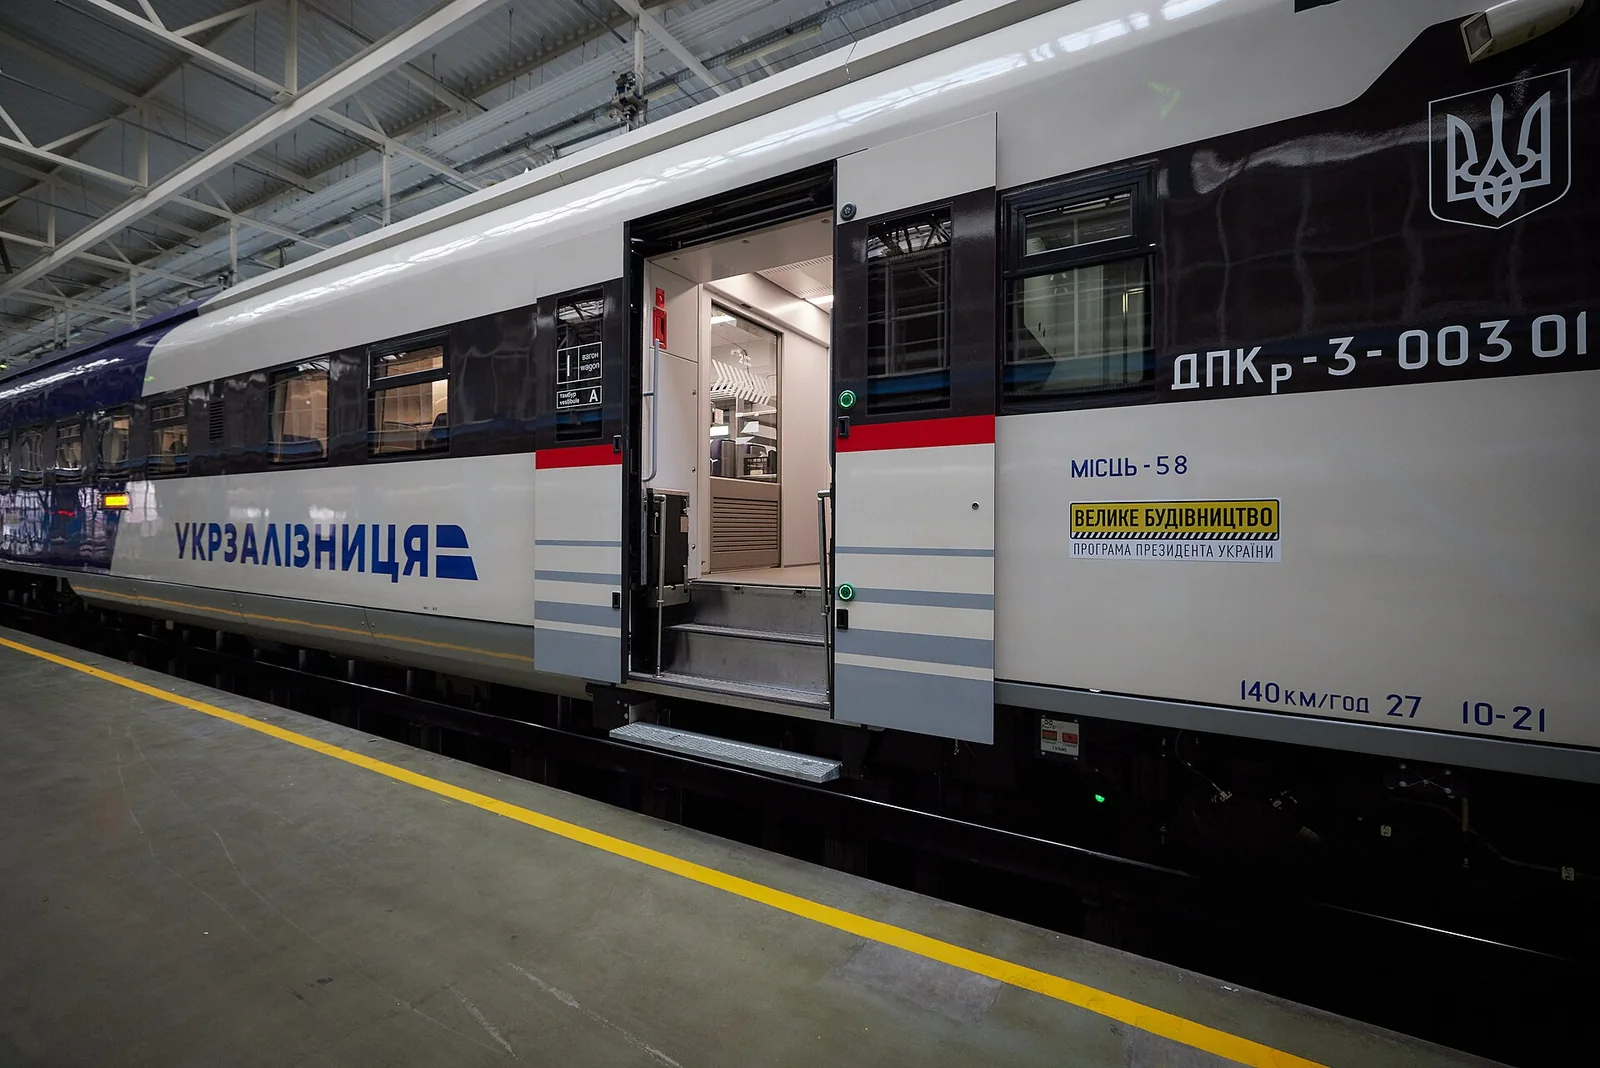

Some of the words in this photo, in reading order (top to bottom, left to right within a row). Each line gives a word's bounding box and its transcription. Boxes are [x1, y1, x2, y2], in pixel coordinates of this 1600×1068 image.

[582, 352, 599, 361] вагон
[580, 362, 600, 372] wagon
[1074, 508, 1139, 527] ВЕЛИКЕ
[1144, 506, 1273, 530] БУДІВНИЦТВО
[175, 522, 428, 583] УКРЗАЛІЗНИЦЯ
[1073, 543, 1131, 557] ПРОГРАМА
[1136, 543, 1214, 559] ПРЕЗИДЕНТА
[1218, 542, 1274, 559] УКРАЇНИ
[1386, 693, 1422, 719] 27
